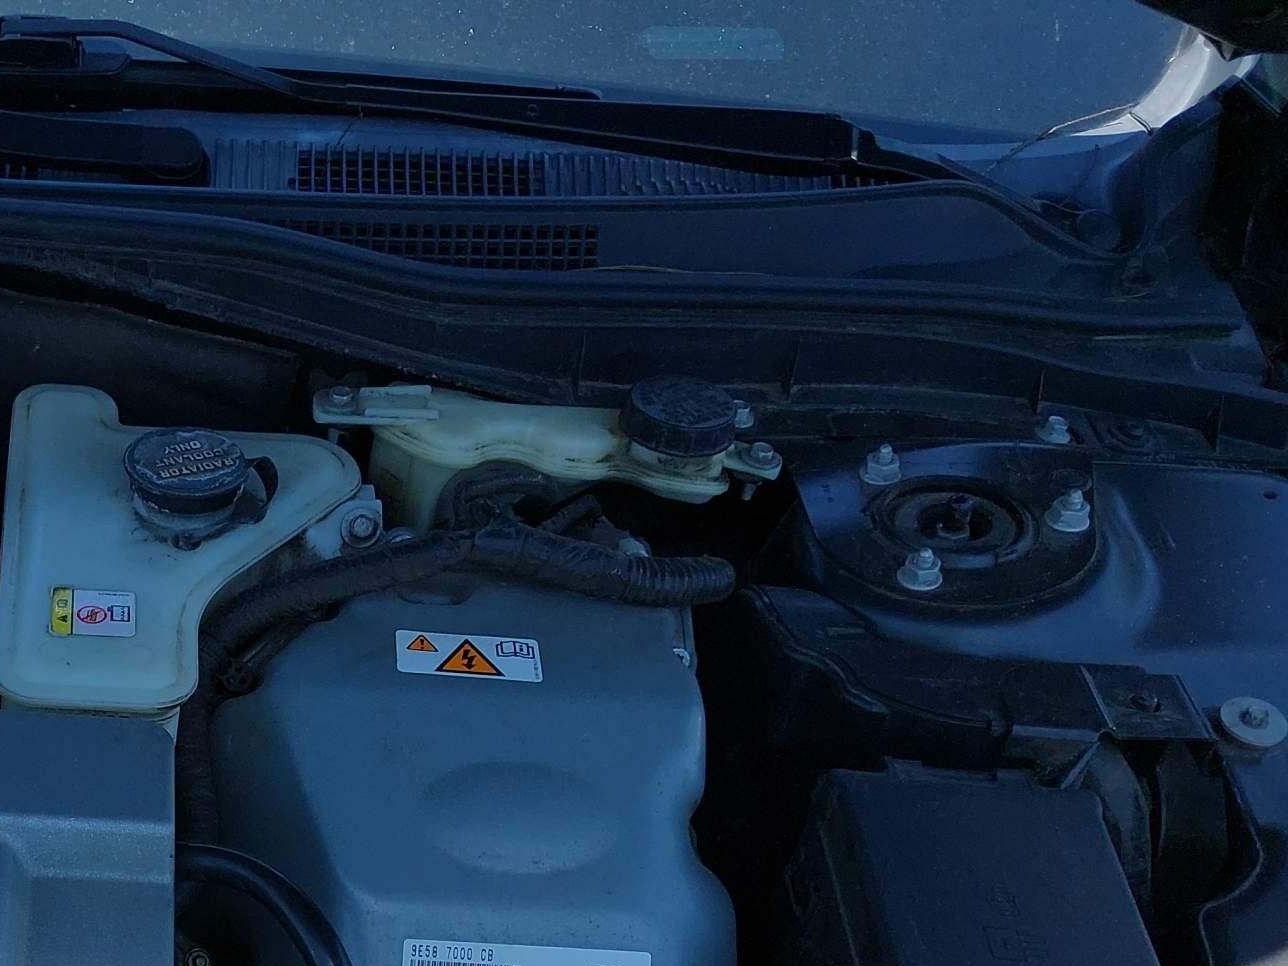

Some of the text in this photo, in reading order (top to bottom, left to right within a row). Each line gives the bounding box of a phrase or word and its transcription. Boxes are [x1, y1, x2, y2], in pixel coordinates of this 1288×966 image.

[163, 439, 200, 454] ONLY
[154, 447, 223, 468] COOLANT
[159, 457, 234, 478] RADIATOR
[411, 944, 494, 962] 9E58 7000 CB
